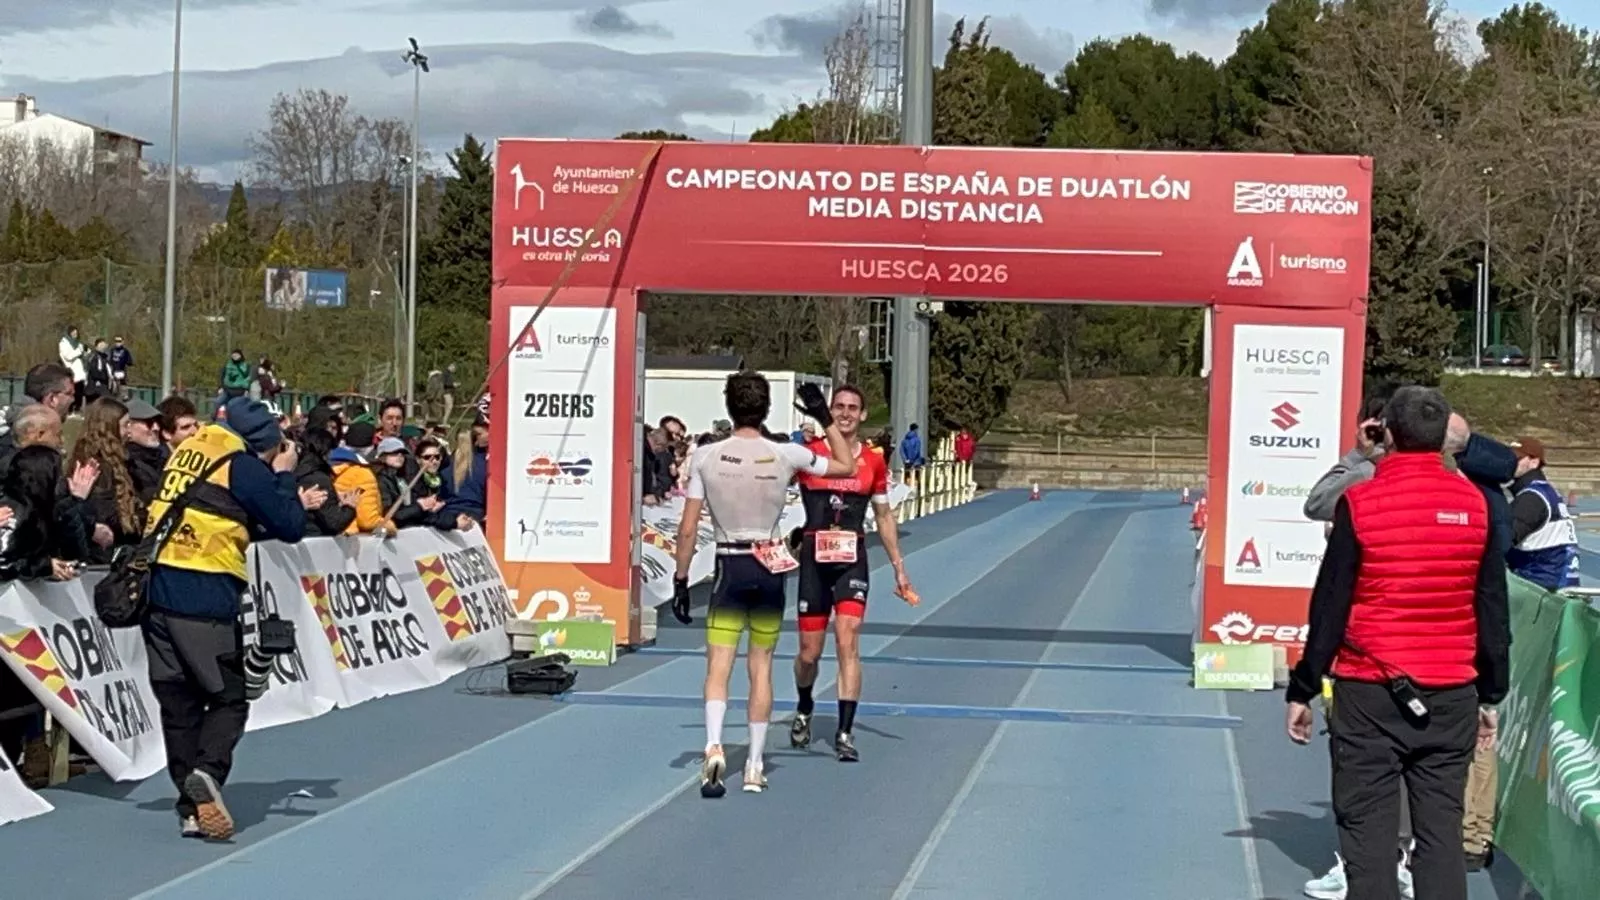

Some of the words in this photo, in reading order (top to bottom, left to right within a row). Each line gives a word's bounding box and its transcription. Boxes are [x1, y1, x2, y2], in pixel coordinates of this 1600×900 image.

[553, 165, 643, 180] Ayuntamient
[552, 181, 569, 193] de
[572, 182, 619, 194] Huesca
[666, 168, 852, 191] CAMPEONATO
[860, 171, 896, 193] DE
[903, 171, 1009, 196] ESPAÑA
[1017, 178, 1053, 197] DE
[1061, 175, 1190, 200] DUATLÓN
[1264, 183, 1348, 200] GOBIERNO
[808, 196, 892, 218] MEDIA
[900, 199, 1043, 223] DISTANCIA
[1265, 198, 1286, 213] DE
[1289, 199, 1358, 215] ARAGON
[512, 226, 621, 248] HUESCA
[1280, 253, 1347, 270] turismo
[841, 259, 941, 282] HUESCA
[948, 263, 1009, 283] 2026
[556, 332, 610, 345] turismo
[1246, 347, 1330, 365] HUESCA
[524, 393, 594, 418] 226ERS
[1249, 435, 1320, 449] SUZUKI
[337, 624, 373, 669] DE
